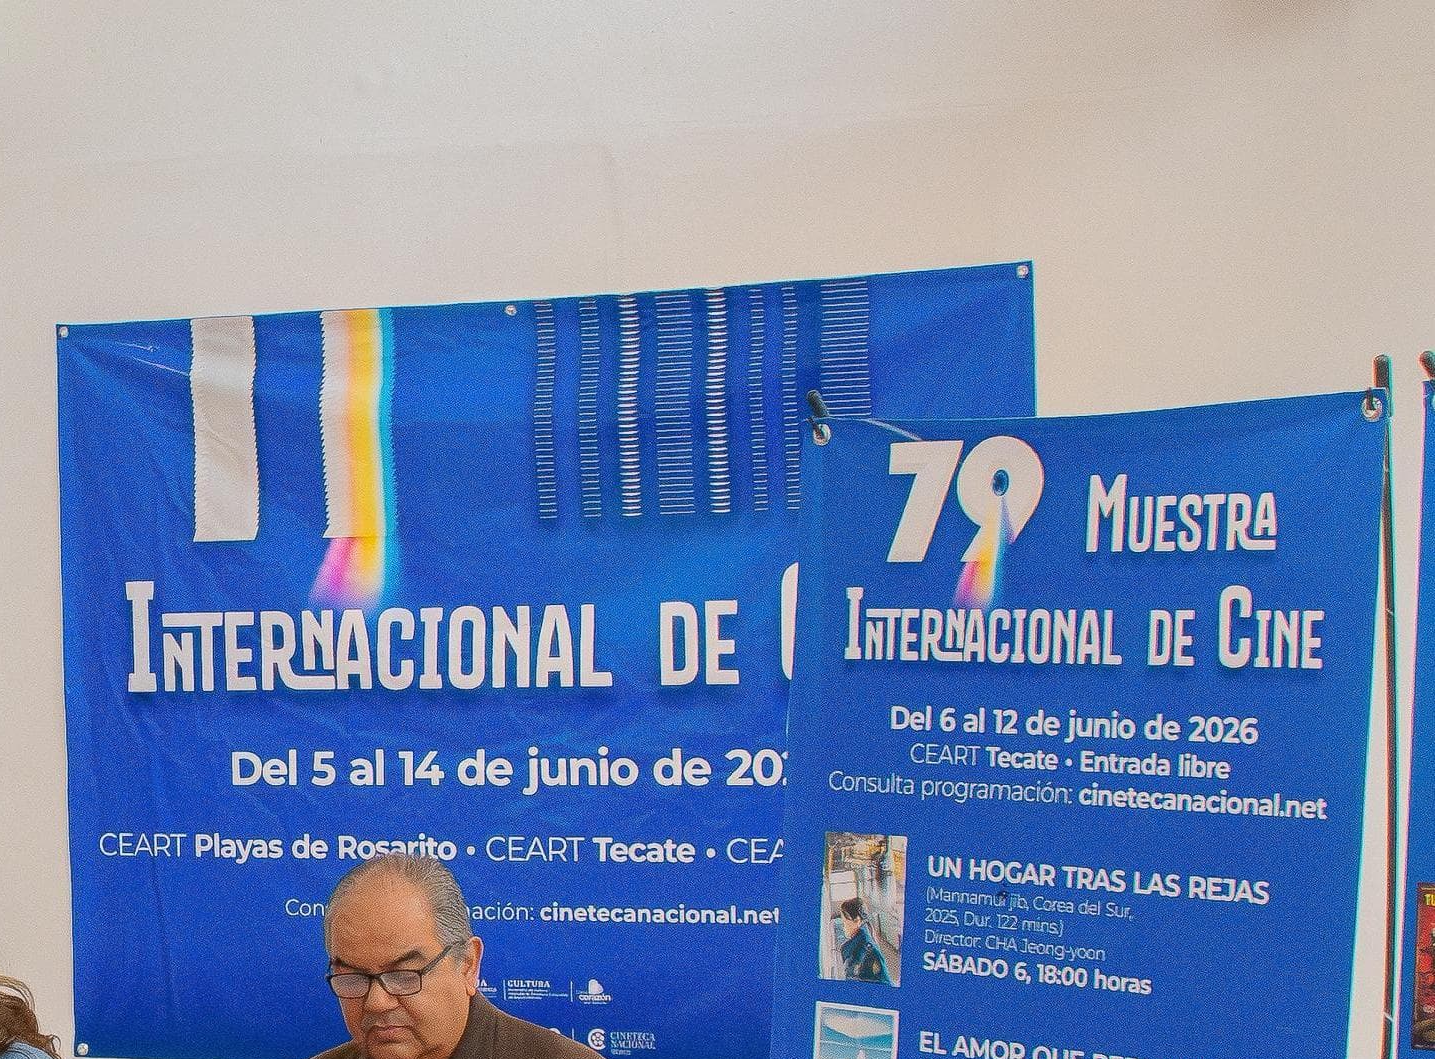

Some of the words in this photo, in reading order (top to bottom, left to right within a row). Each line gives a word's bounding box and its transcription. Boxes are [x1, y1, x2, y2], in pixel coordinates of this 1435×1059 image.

[887, 435, 1044, 563] 79
[1085, 474, 1277, 553] MUESTRA
[125, 581, 612, 692] INTERNACIONAL
[660, 600, 740, 686] DE
[845, 586, 1122, 665] INTERNACIONAL
[1147, 611, 1195, 667] DE
[1218, 585, 1325, 669] CINE
[891, 705, 932, 731] Del
[939, 708, 956, 732] 6
[963, 707, 985, 734] al
[994, 709, 1017, 735] 12
[1025, 710, 1061, 736] de
[1064, 709, 1136, 743] junio
[1144, 714, 1181, 741] de
[1188, 716, 1259, 745] 2026
[231, 750, 297, 786] Del
[312, 751, 336, 787] 5
[350, 750, 385, 787] al
[399, 751, 444, 787] 14
[458, 749, 513, 787] de
[523, 746, 639, 795] junio
[653, 747, 712, 787] de
[910, 743, 981, 767] CEART
[986, 746, 1059, 770] Tecate
[1080, 750, 1171, 777] Entrada
[1178, 753, 1230, 780] libre
[828, 770, 915, 796] Consulta
[922, 780, 1072, 804] programación:
[1079, 782, 1328, 820] cinetecanacional.net
[99, 832, 187, 858] CEART
[195, 832, 284, 864] Playas
[292, 833, 328, 859] de
[337, 833, 457, 861] Rosarito
[486, 836, 585, 863] CEART
[593, 837, 696, 864] Tecate
[926, 855, 962, 880] UN
[969, 859, 1056, 888] HOGAR
[1062, 866, 1126, 894] TRAS
[1133, 871, 1183, 897] LAS
[1189, 876, 1270, 905] REJAS
[540, 901, 779, 926] cinetecanacional.net
[964, 911, 992, 928] Dur.
[997, 914, 1018, 930] 122
[1033, 896, 1074, 914] Corea
[1078, 900, 1101, 916] del
[985, 935, 1017, 951] CHA
[1021, 938, 1106, 962] Jeong-yoon
[923, 950, 1008, 979] SÁBADO
[1015, 962, 1032, 985] 6,
[1037, 963, 1088, 987] 18:00
[1094, 969, 1152, 996] horas
[919, 1030, 947, 1056] EL
